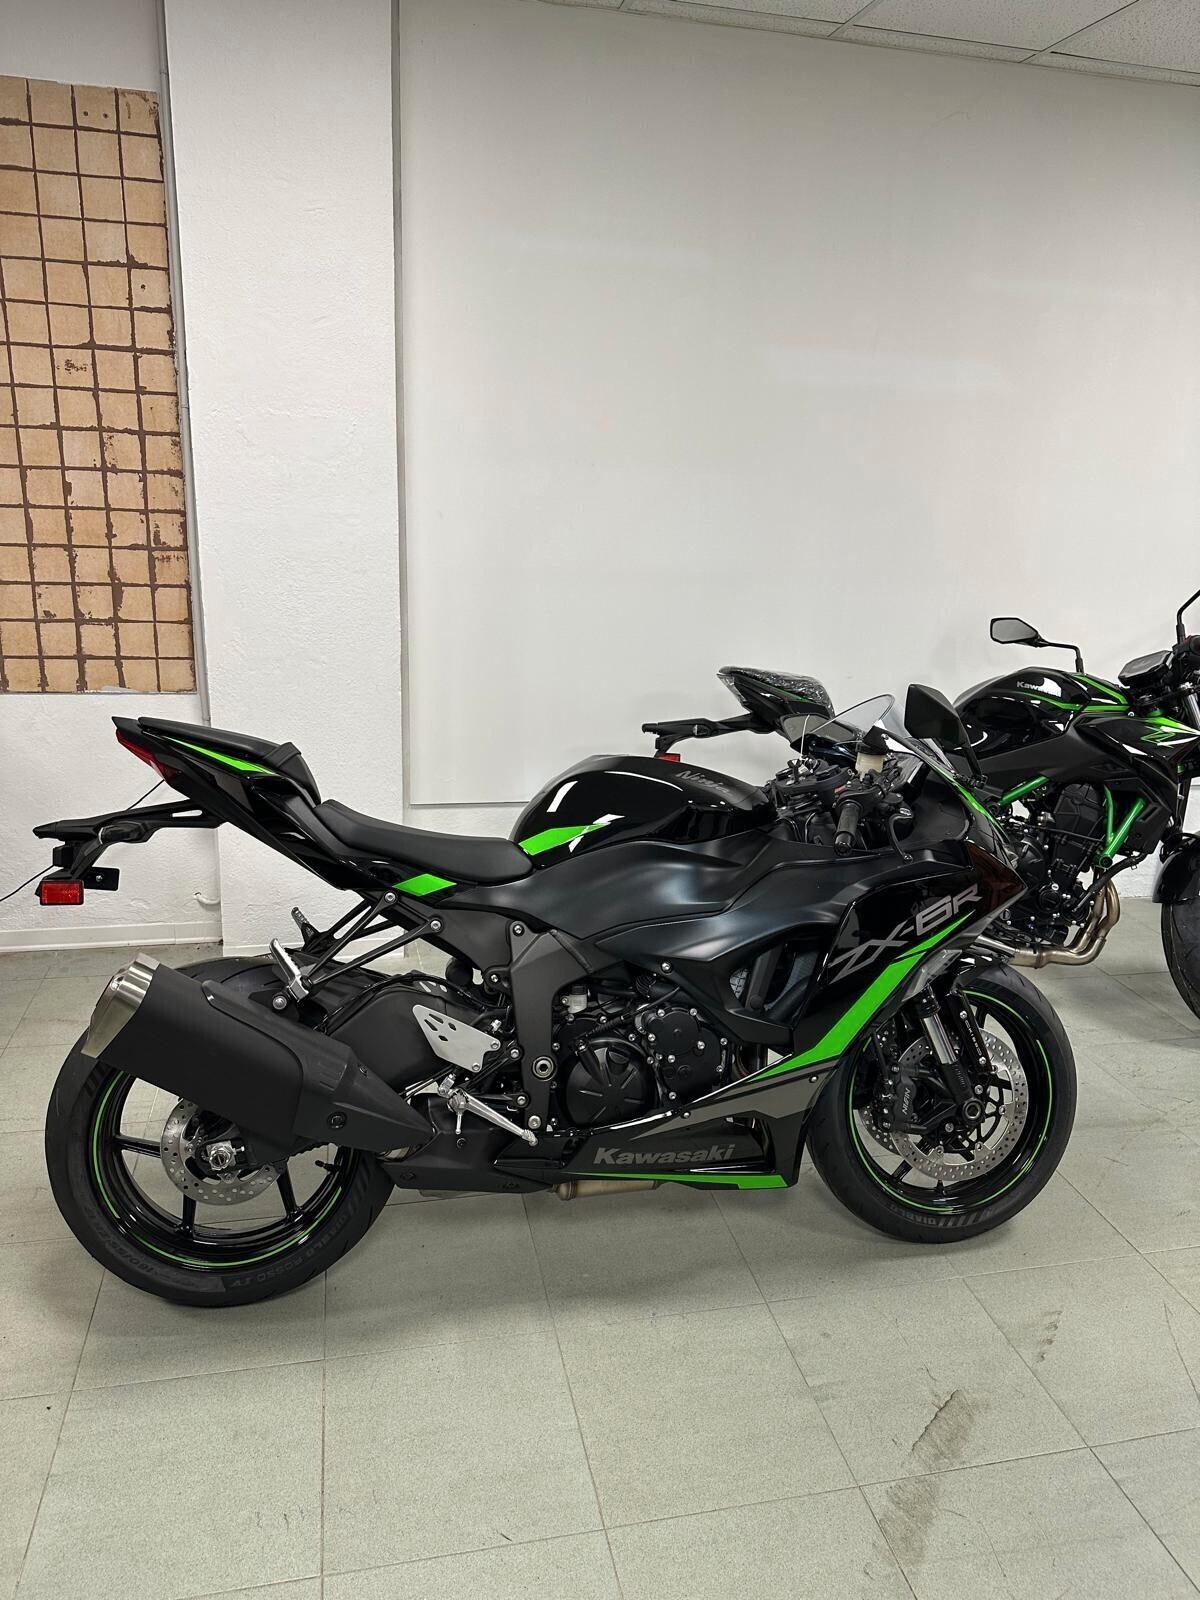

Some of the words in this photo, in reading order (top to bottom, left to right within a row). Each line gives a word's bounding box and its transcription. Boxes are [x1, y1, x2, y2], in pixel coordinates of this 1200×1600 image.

[676, 770, 731, 795] Ninja
[828, 884, 982, 984] ZX-6R
[594, 1145, 735, 1166] Kawasaki
